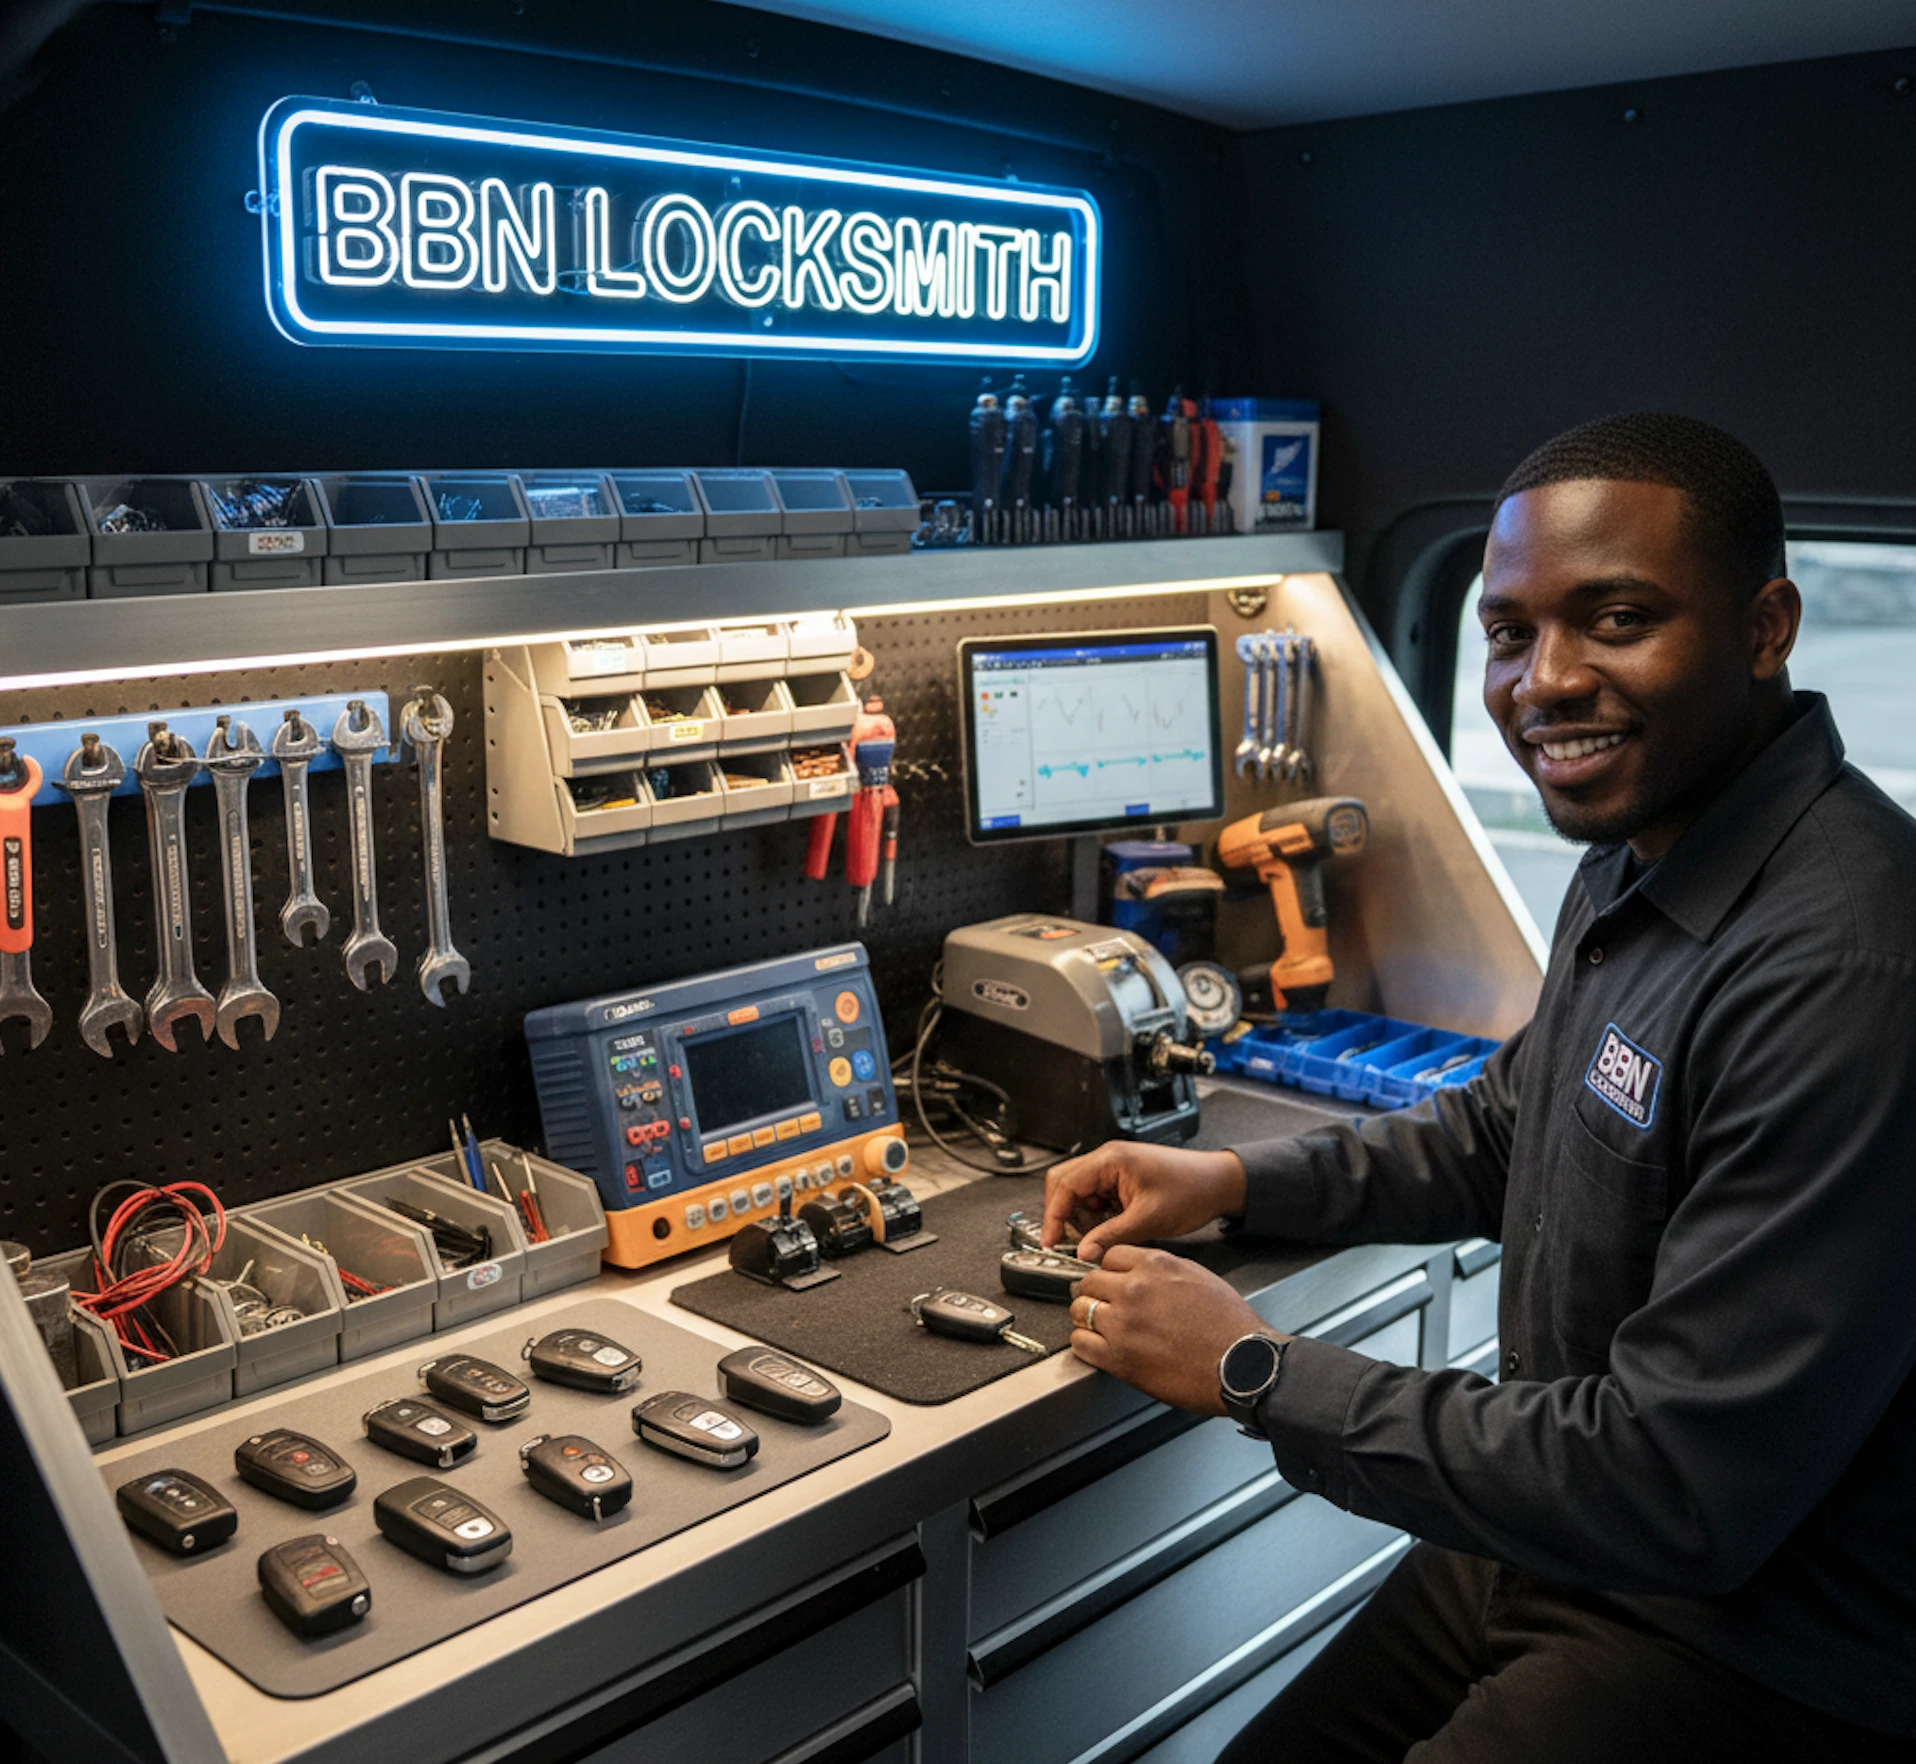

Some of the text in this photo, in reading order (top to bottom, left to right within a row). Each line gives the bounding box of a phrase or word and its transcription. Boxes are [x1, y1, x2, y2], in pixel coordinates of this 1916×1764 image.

[315, 164, 1072, 324] BBN LOCKSMITH
[1597, 1032, 1653, 1102] BBN
